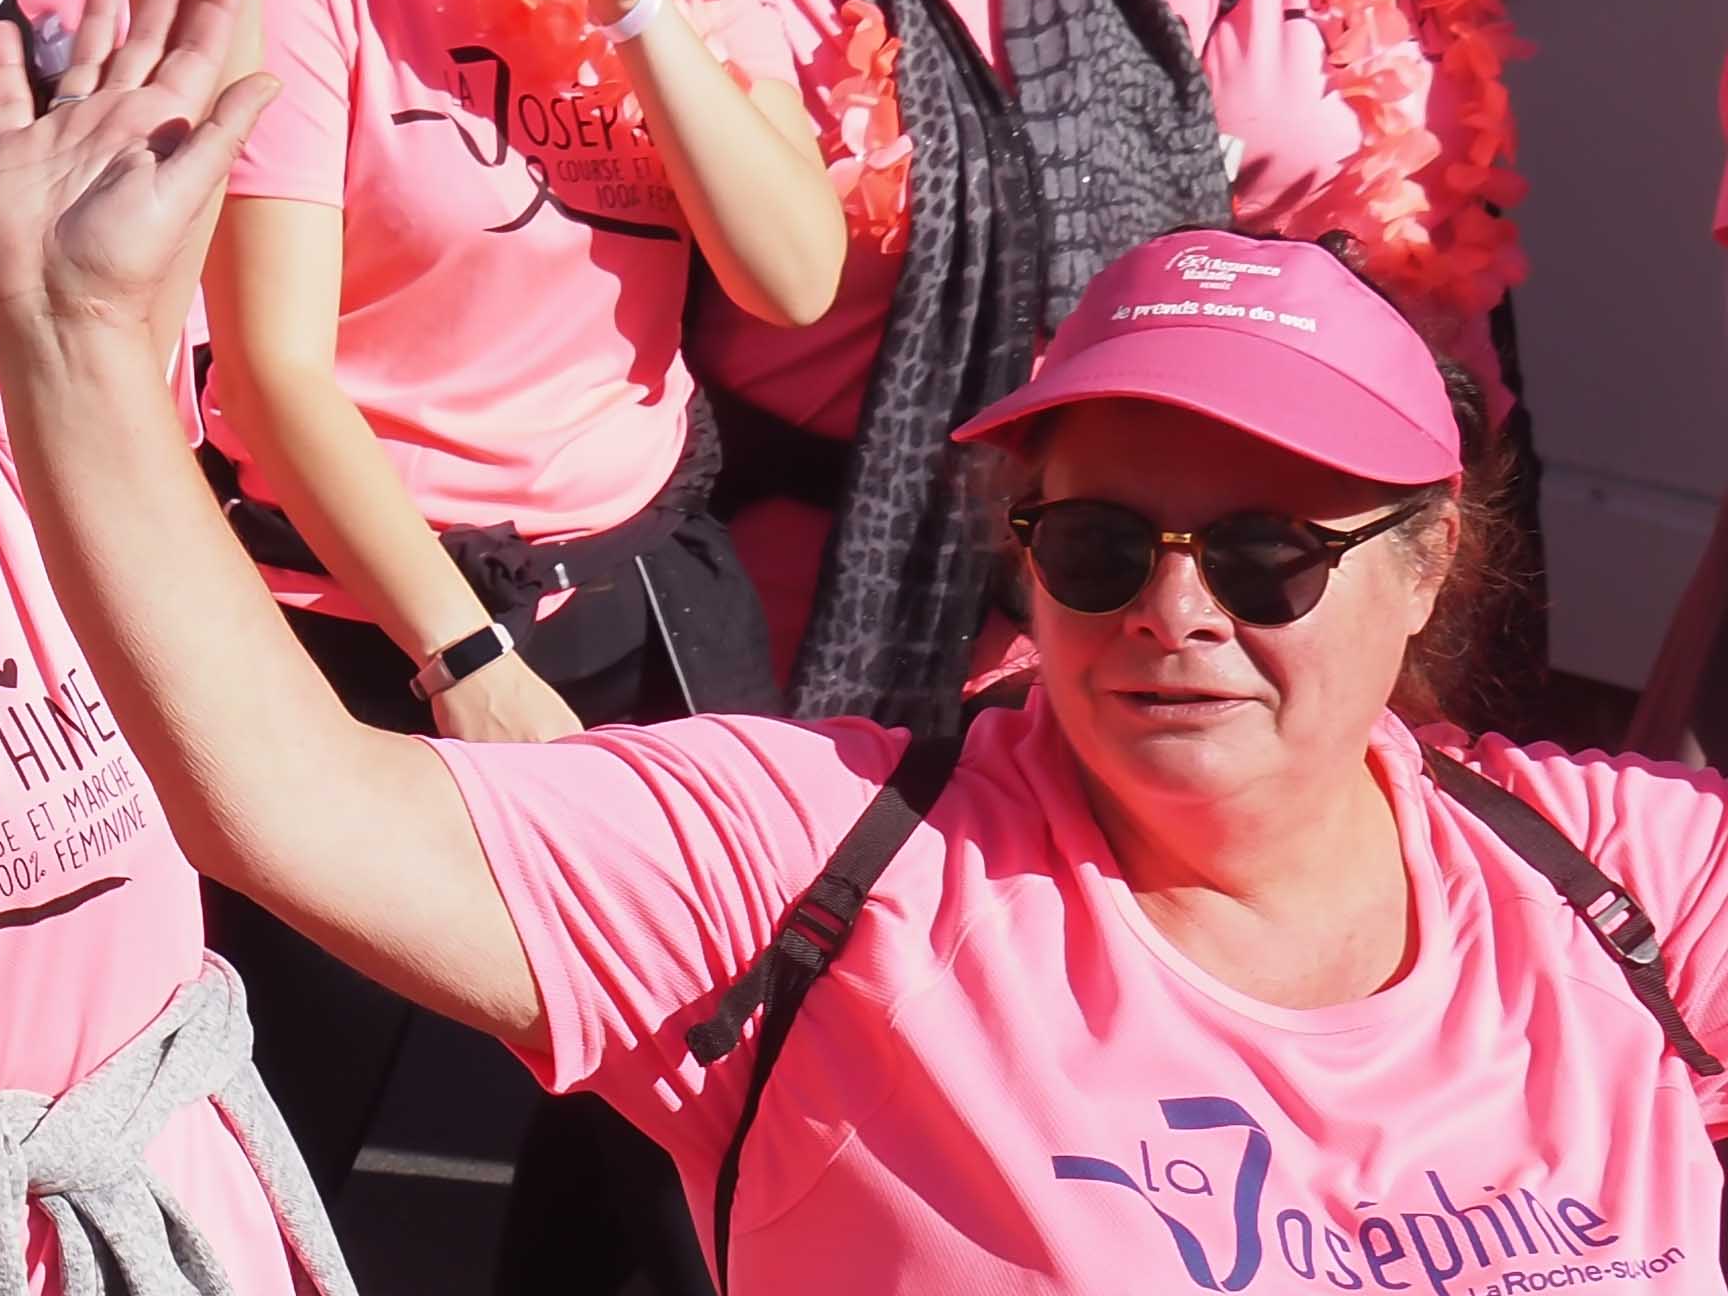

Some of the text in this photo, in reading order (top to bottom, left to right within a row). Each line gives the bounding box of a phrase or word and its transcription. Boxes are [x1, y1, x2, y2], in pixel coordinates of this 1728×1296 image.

[1131, 301, 1200, 321] prends
[1203, 303, 1246, 317] soin
[1249, 306, 1275, 322] de
[1279, 312, 1318, 333] moi
[29, 801, 54, 842] ET
[62, 755, 136, 821] MARCHE
[53, 792, 148, 873] FÉMININE
[1140, 1139, 1215, 1197] la
